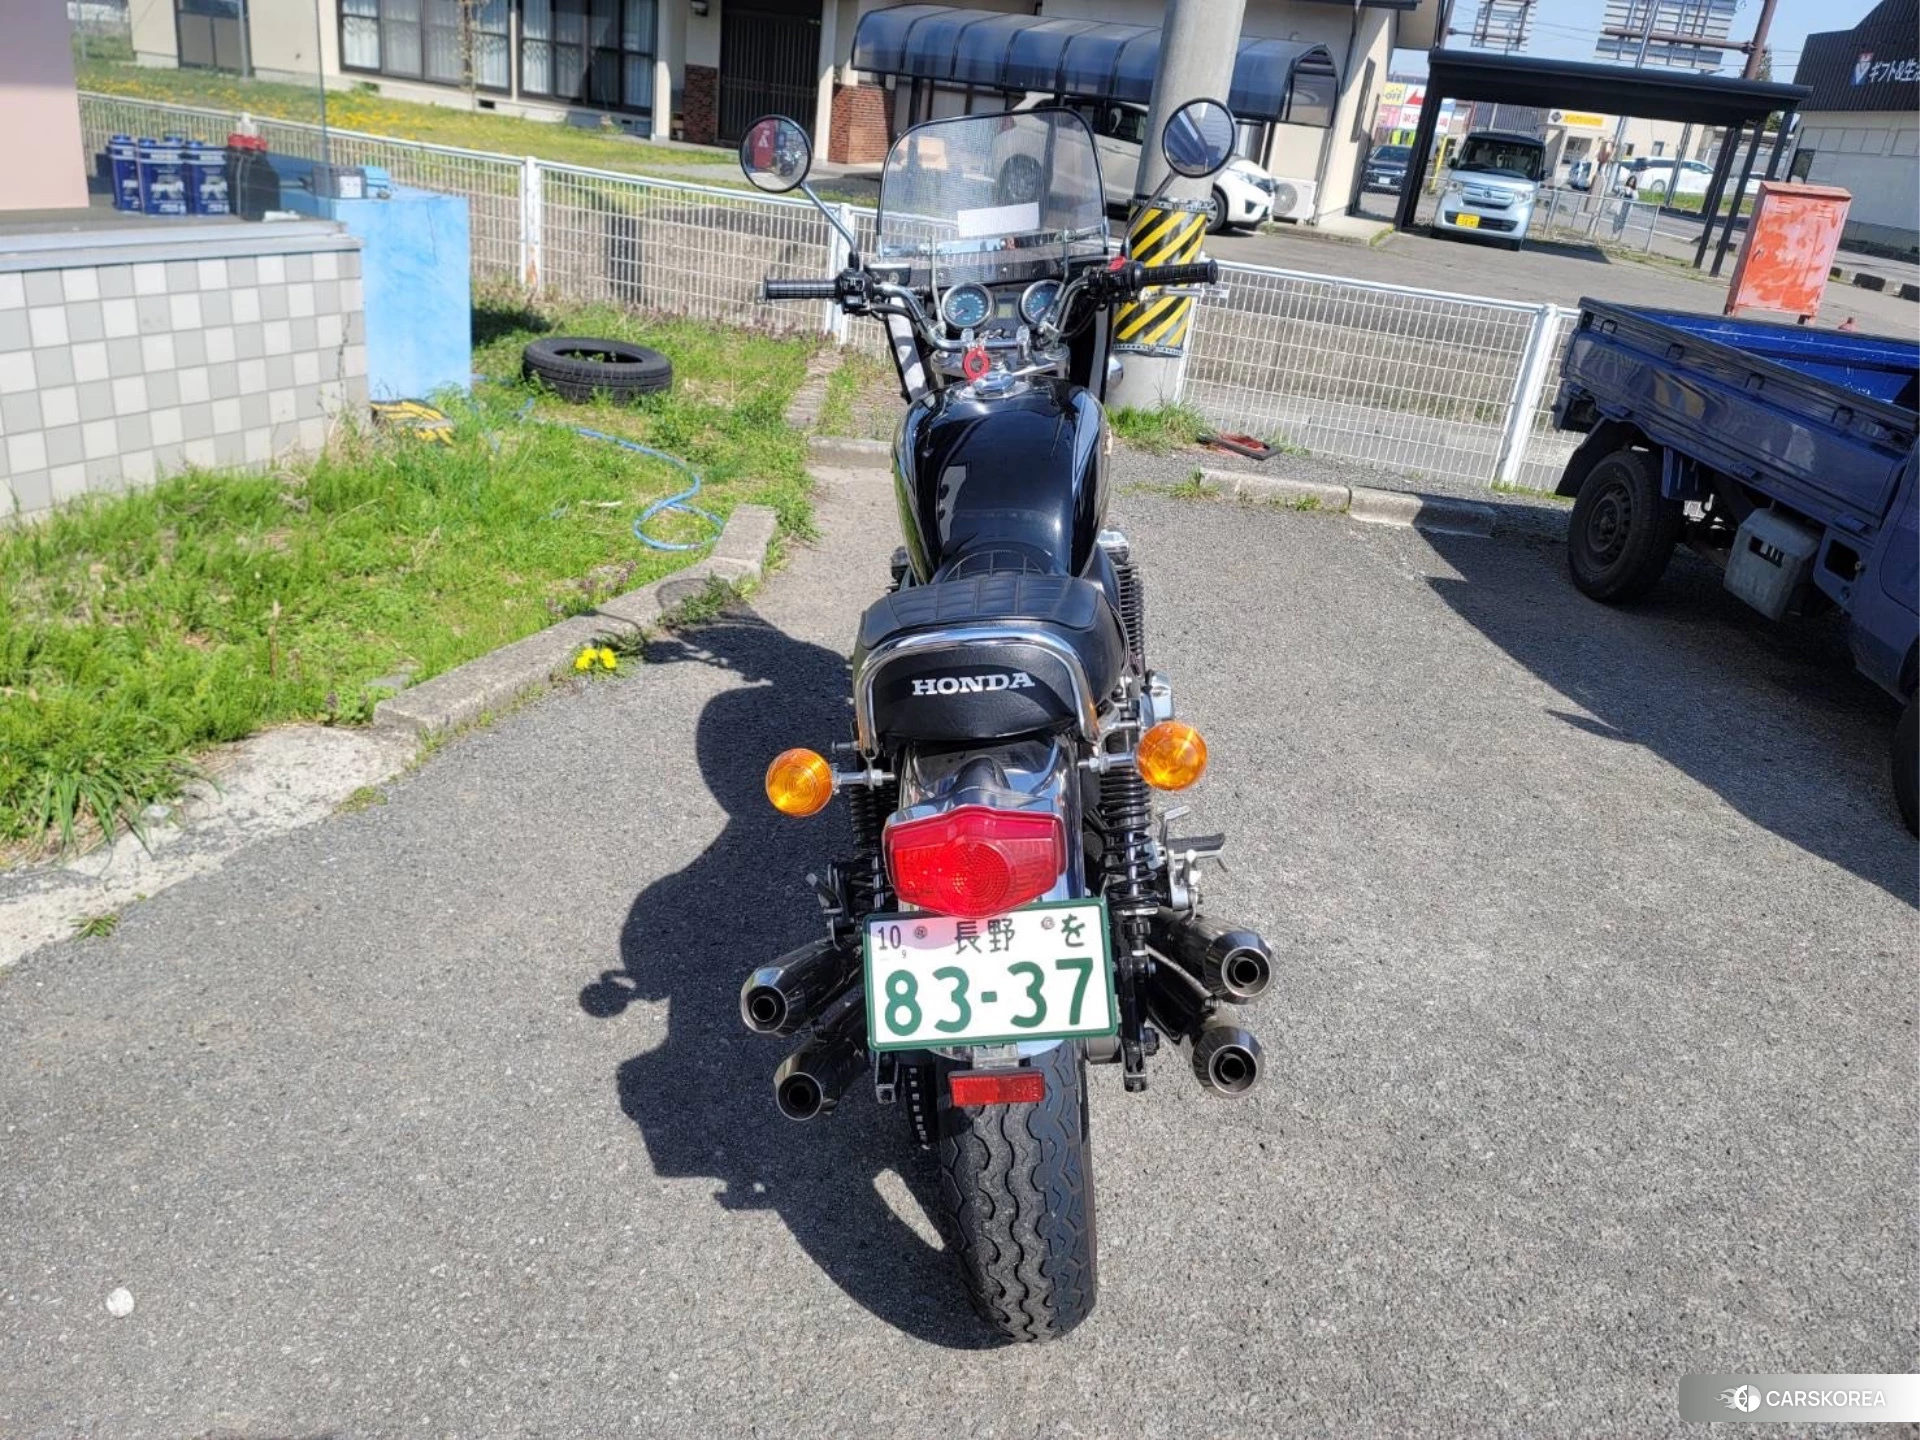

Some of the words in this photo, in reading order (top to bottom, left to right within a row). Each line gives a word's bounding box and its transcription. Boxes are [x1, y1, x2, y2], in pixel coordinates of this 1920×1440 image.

[912, 672, 1035, 695] HONDA
[878, 925, 901, 950] 10
[955, 918, 1015, 954] 長野
[1061, 914, 1085, 948] を
[885, 957, 1094, 1036] 83-37
